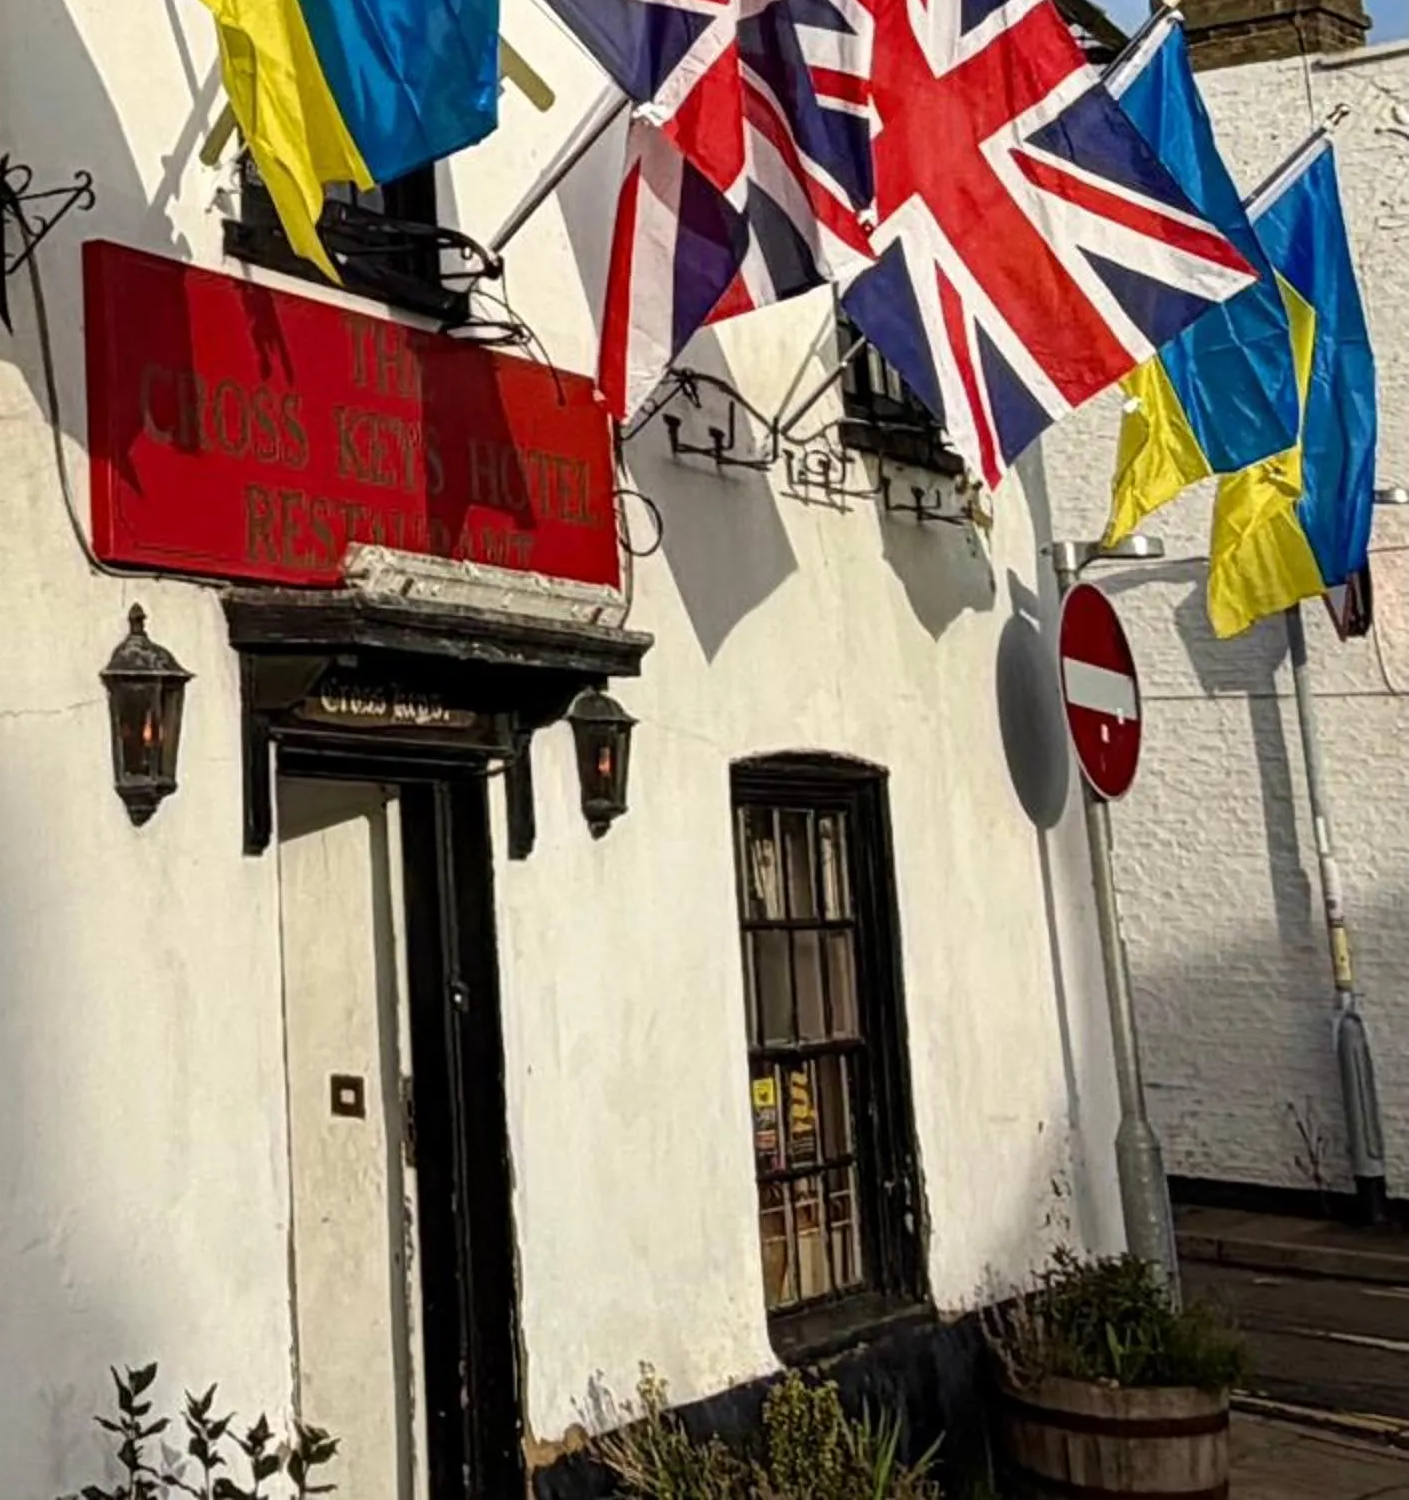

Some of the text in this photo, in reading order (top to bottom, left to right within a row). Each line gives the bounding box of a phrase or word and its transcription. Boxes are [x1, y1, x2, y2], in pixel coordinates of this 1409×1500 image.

[343, 314, 429, 398] THE
[141, 364, 597, 525] CROSS KEYS HOTEL
[321, 677, 387, 715] Cross
